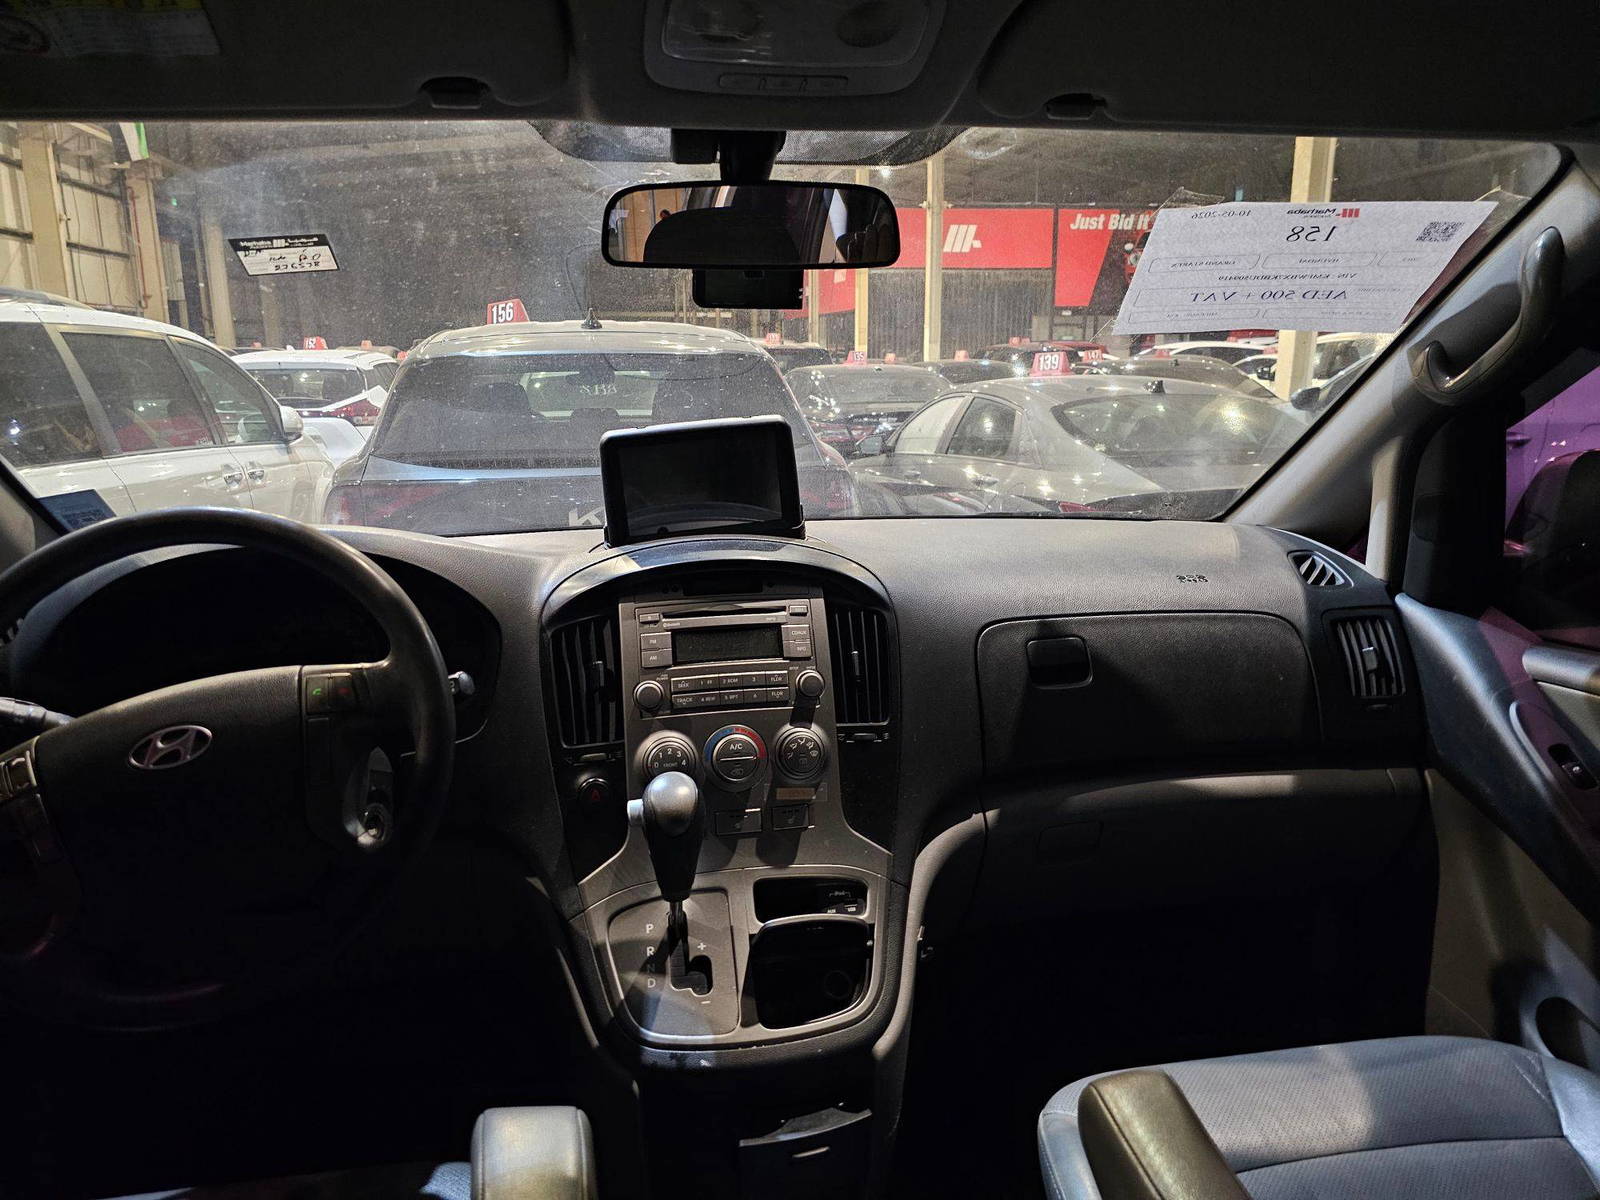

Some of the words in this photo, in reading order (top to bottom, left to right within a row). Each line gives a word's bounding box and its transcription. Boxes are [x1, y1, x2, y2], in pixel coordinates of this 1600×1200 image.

[1070, 213, 1106, 230] Just
[1108, 213, 1135, 231] Bid
[1136, 213, 1150, 231] It
[491, 302, 514, 324] 156
[1039, 354, 1059, 371] 139
[646, 923, 654, 933] P
[646, 946, 655, 956] R
[648, 963, 656, 973] N
[648, 978, 657, 989] D
